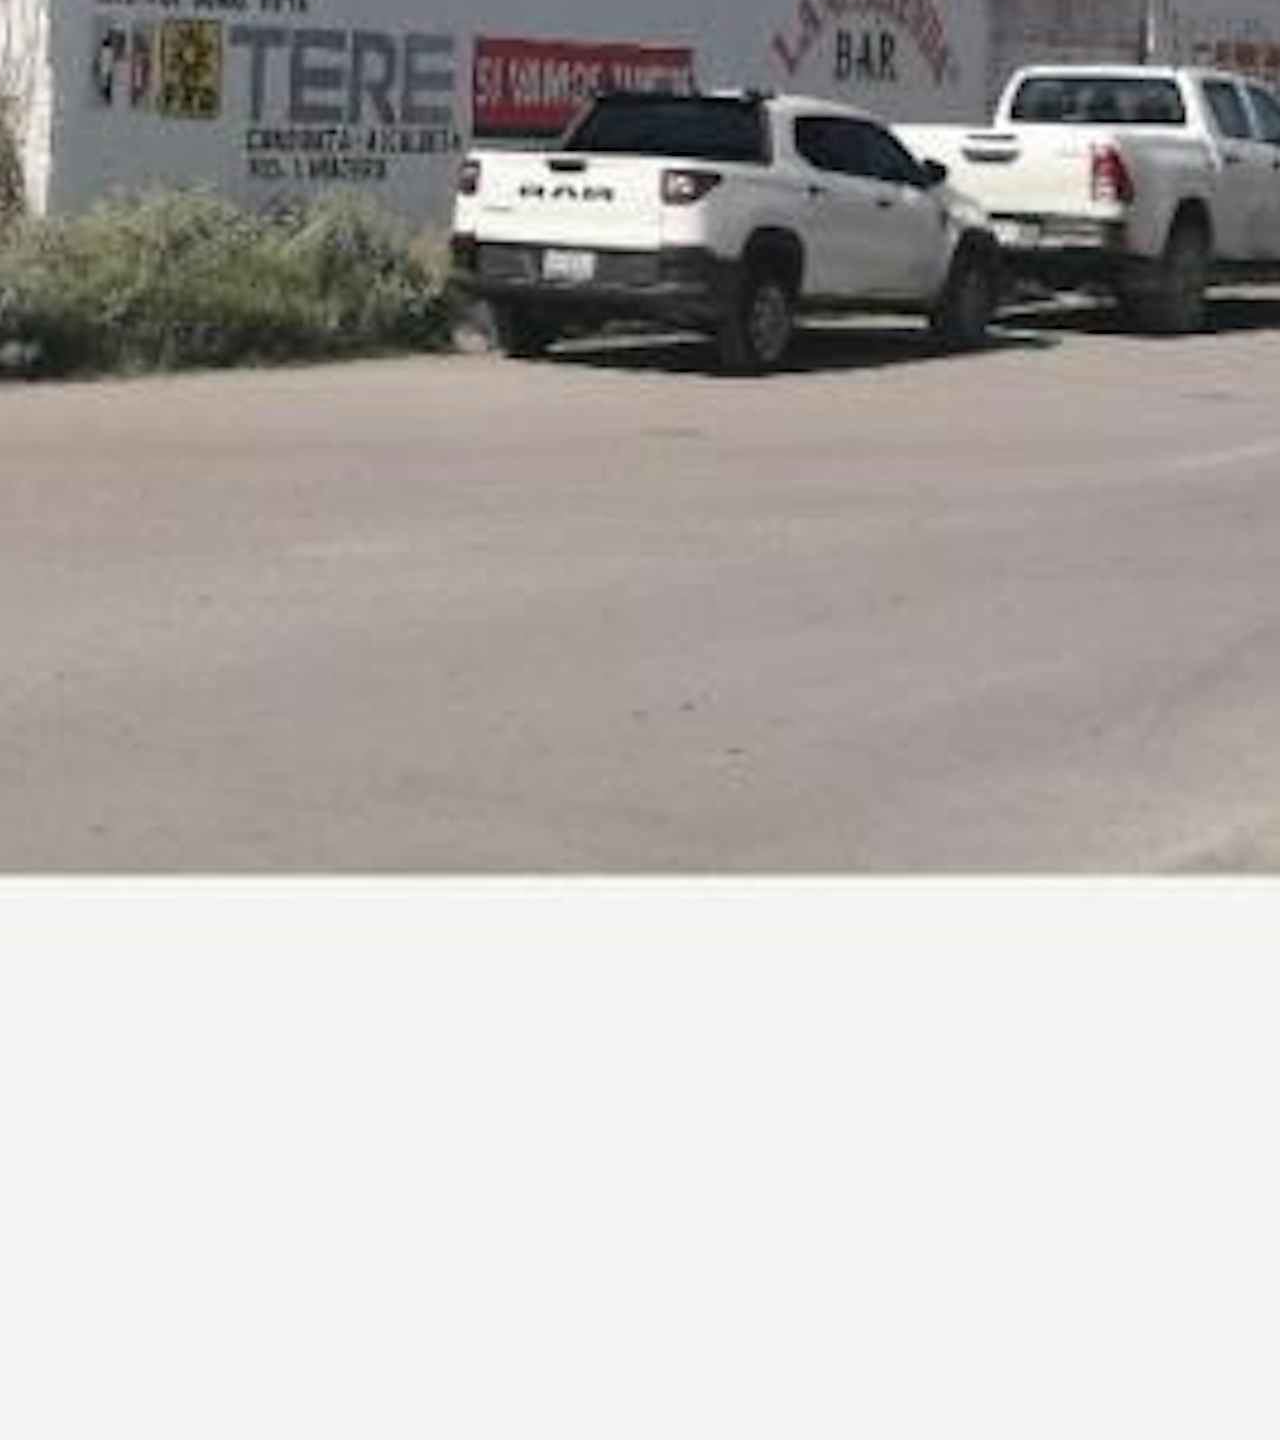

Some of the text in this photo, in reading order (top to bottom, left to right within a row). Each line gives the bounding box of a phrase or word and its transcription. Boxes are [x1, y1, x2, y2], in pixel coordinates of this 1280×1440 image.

[228, 26, 456, 125] TERE
[834, 27, 897, 83] BAR
[519, 185, 613, 203] RAM
